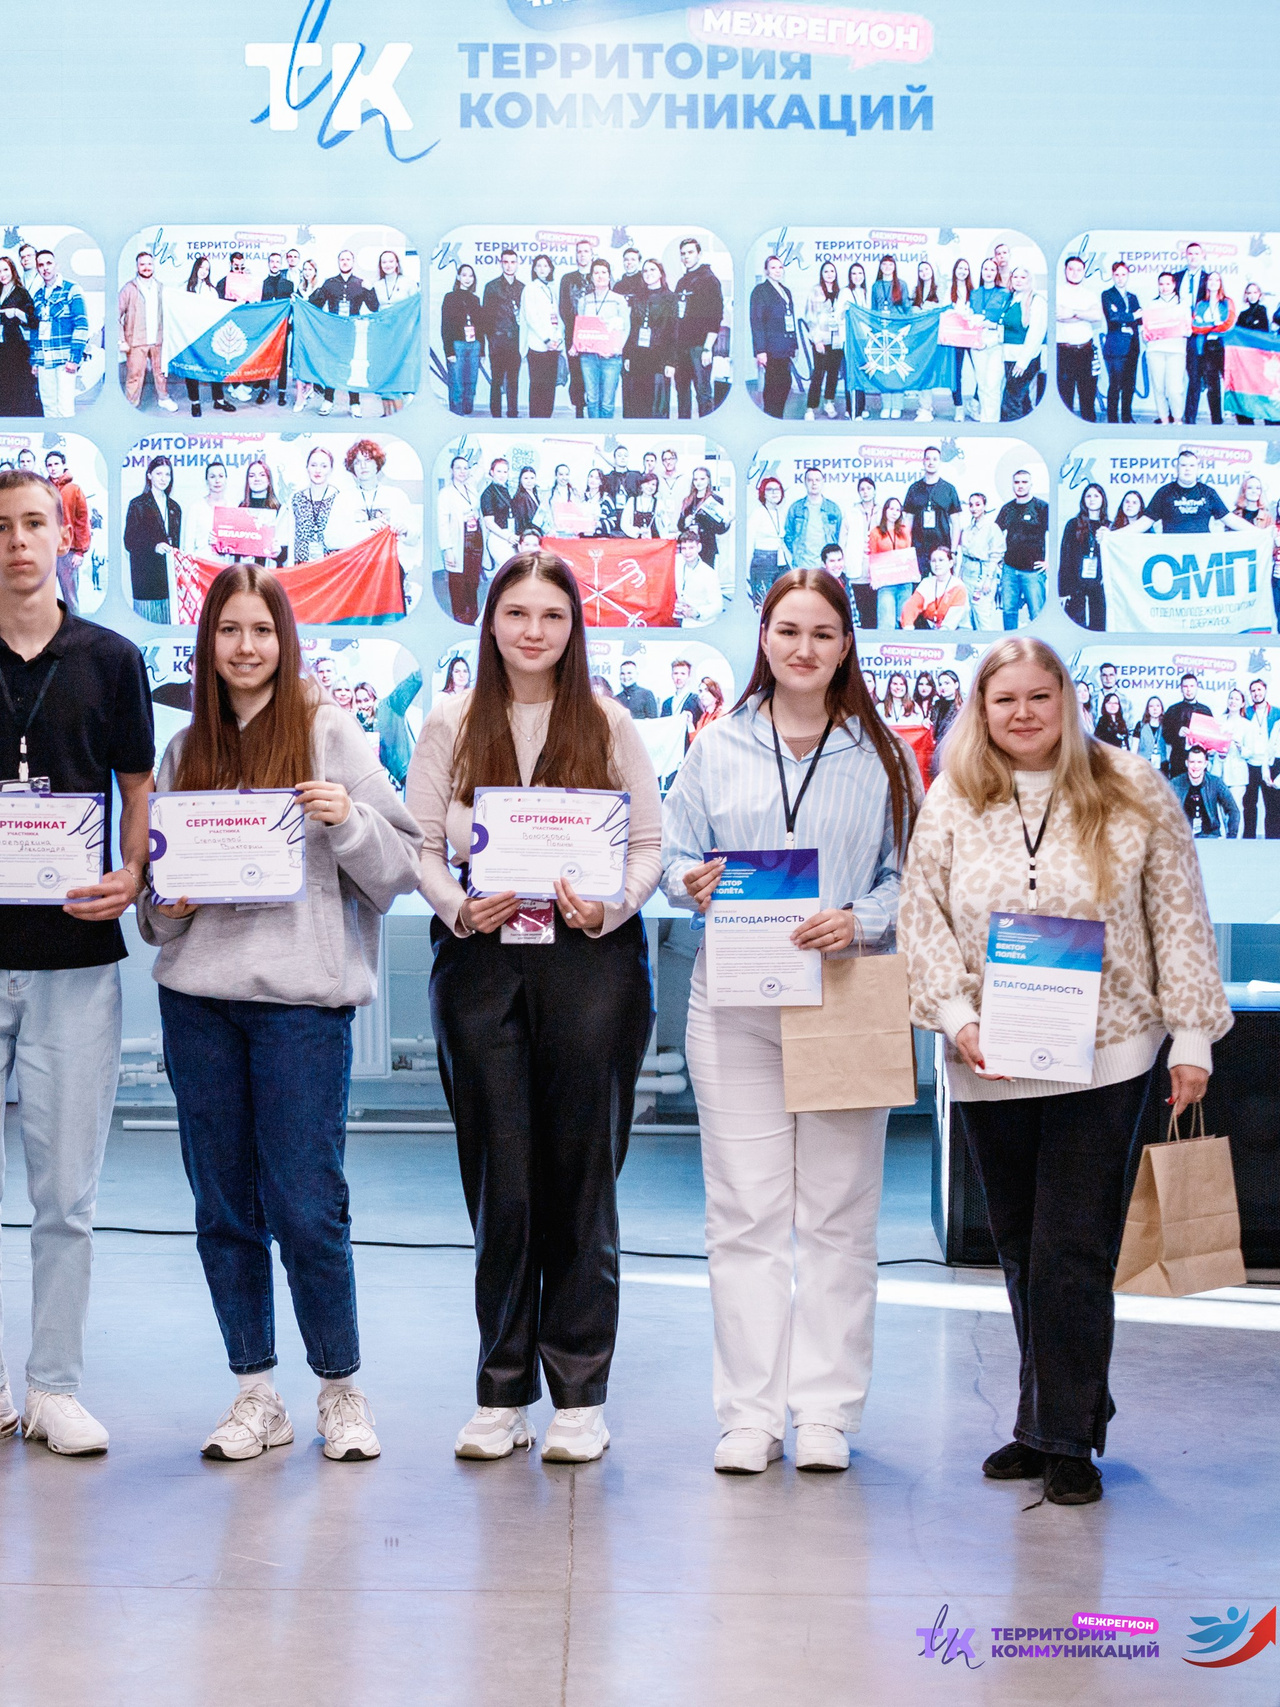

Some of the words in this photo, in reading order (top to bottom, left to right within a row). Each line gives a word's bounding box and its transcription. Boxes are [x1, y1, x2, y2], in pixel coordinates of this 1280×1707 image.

[703, 9, 918, 50] МЕЖРЕГИОН
[458, 41, 812, 81] ТЕРРИТОРИЯ
[458, 85, 934, 137] КОММУНИКАЦИЙ
[187, 241, 261, 249] ТЕРРИТОРИЯ
[475, 242, 568, 252] ТЕРРИТОРИЯ
[815, 241, 898, 250] ТЕРРИТОРИЯ
[794, 459, 893, 469] ТЕРРИТОРИЯ
[1142, 549, 1257, 601] ОМП
[186, 817, 267, 827] СЕРТИФИКАТ
[510, 815, 592, 825] СЕРТИФИКАТ
[714, 915, 805, 924] БЛАГОДАРНОСТЬ
[993, 980, 1084, 995] БЛАГОДАРНОСТЬ
